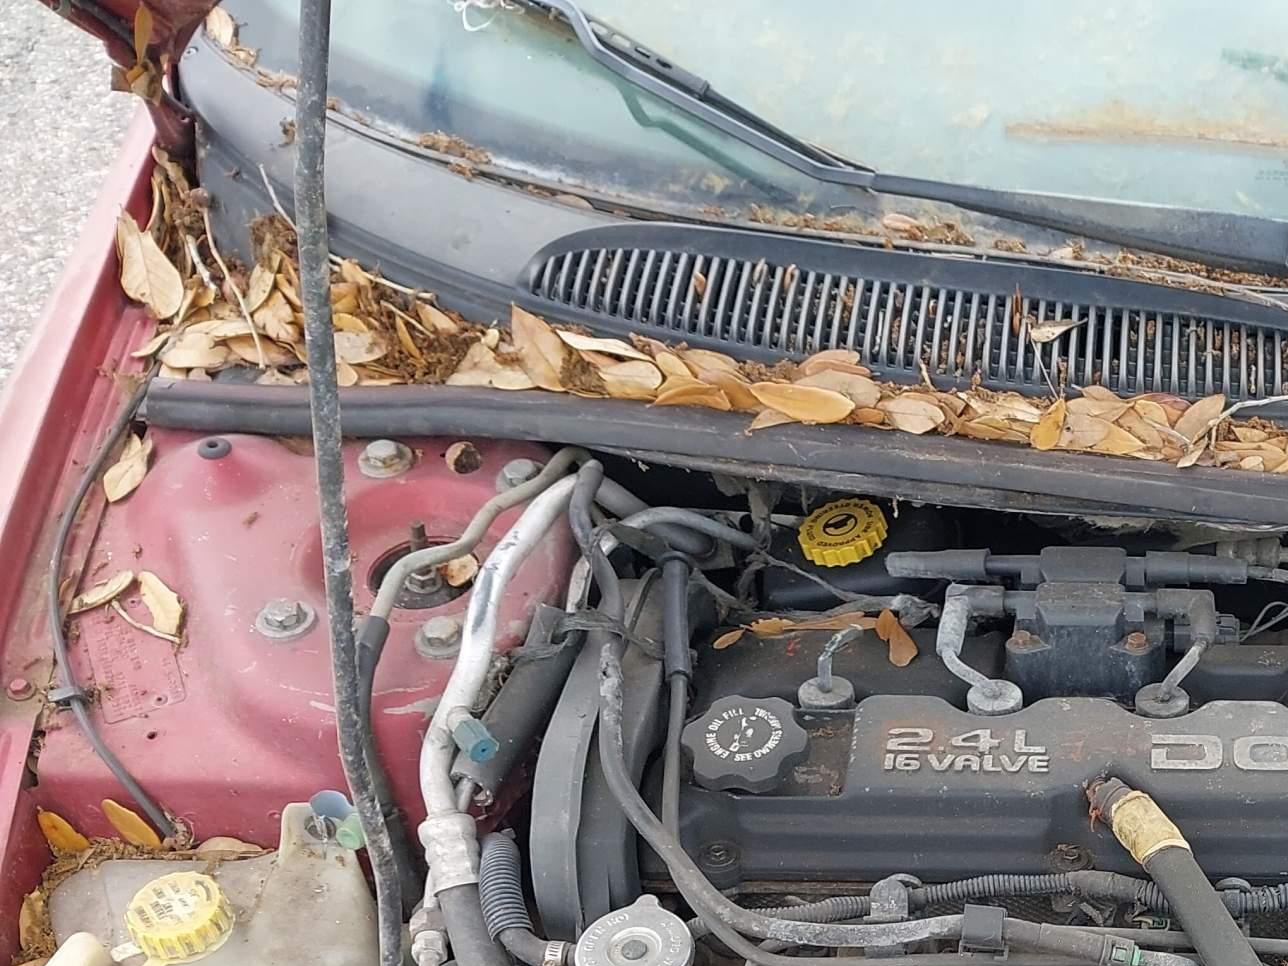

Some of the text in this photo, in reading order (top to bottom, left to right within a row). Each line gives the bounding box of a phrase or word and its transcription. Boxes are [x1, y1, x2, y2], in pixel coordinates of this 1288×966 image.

[705, 707, 745, 759] ENGINE OIL FILL
[733, 752, 754, 762] SEE
[882, 753, 1050, 774] 16 VALVE
